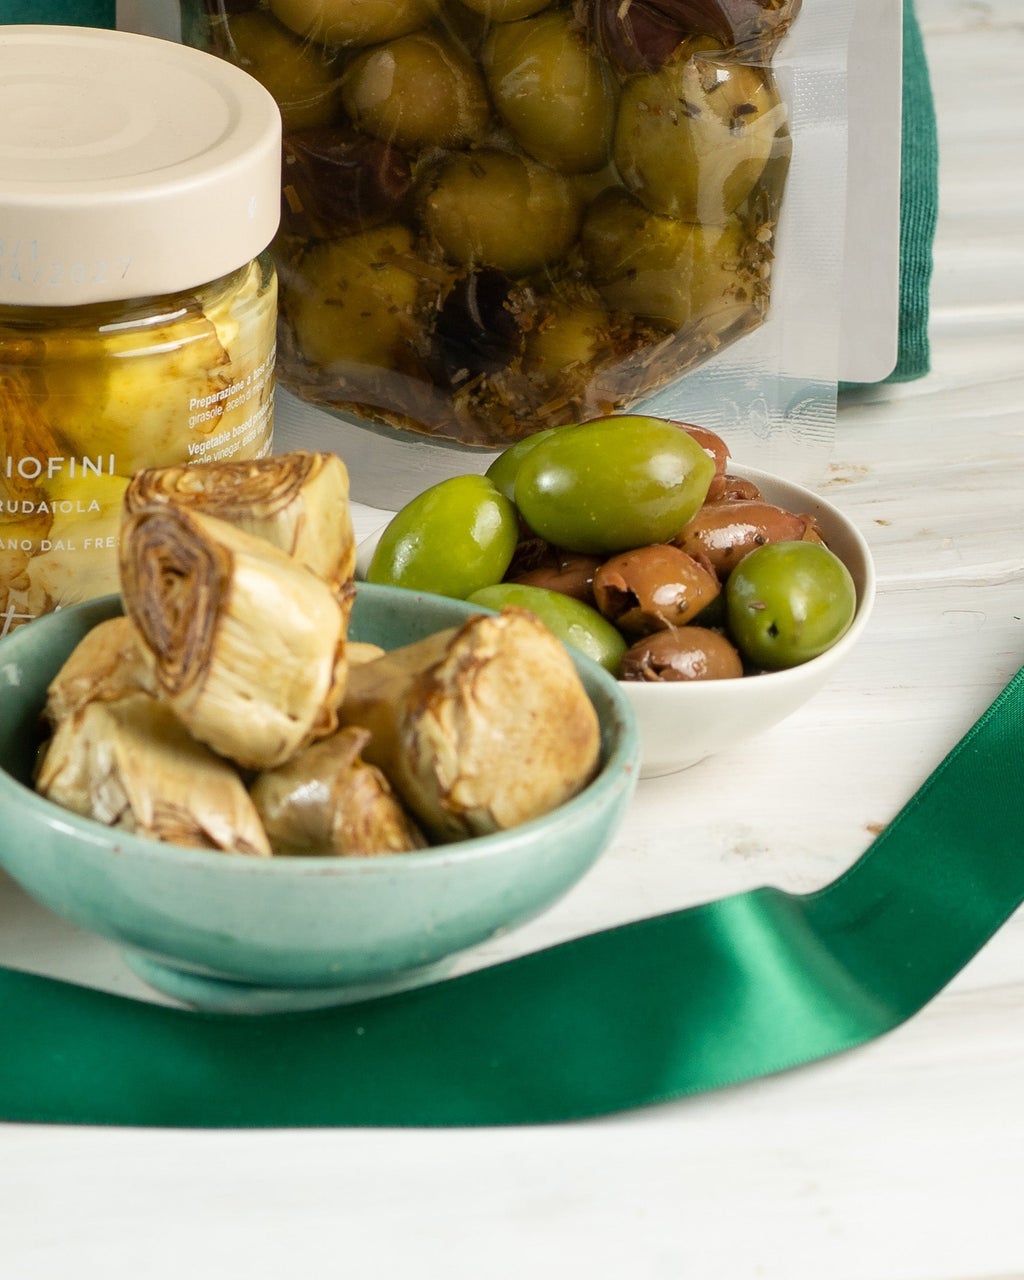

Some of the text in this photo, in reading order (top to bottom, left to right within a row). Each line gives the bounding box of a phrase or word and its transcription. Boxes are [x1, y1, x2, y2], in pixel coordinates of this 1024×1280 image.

[189, 380, 245, 411] Preparazione
[188, 431, 231, 456] Vegetable
[41, 537, 76, 551] DAL
[84, 536, 120, 548] FRE
